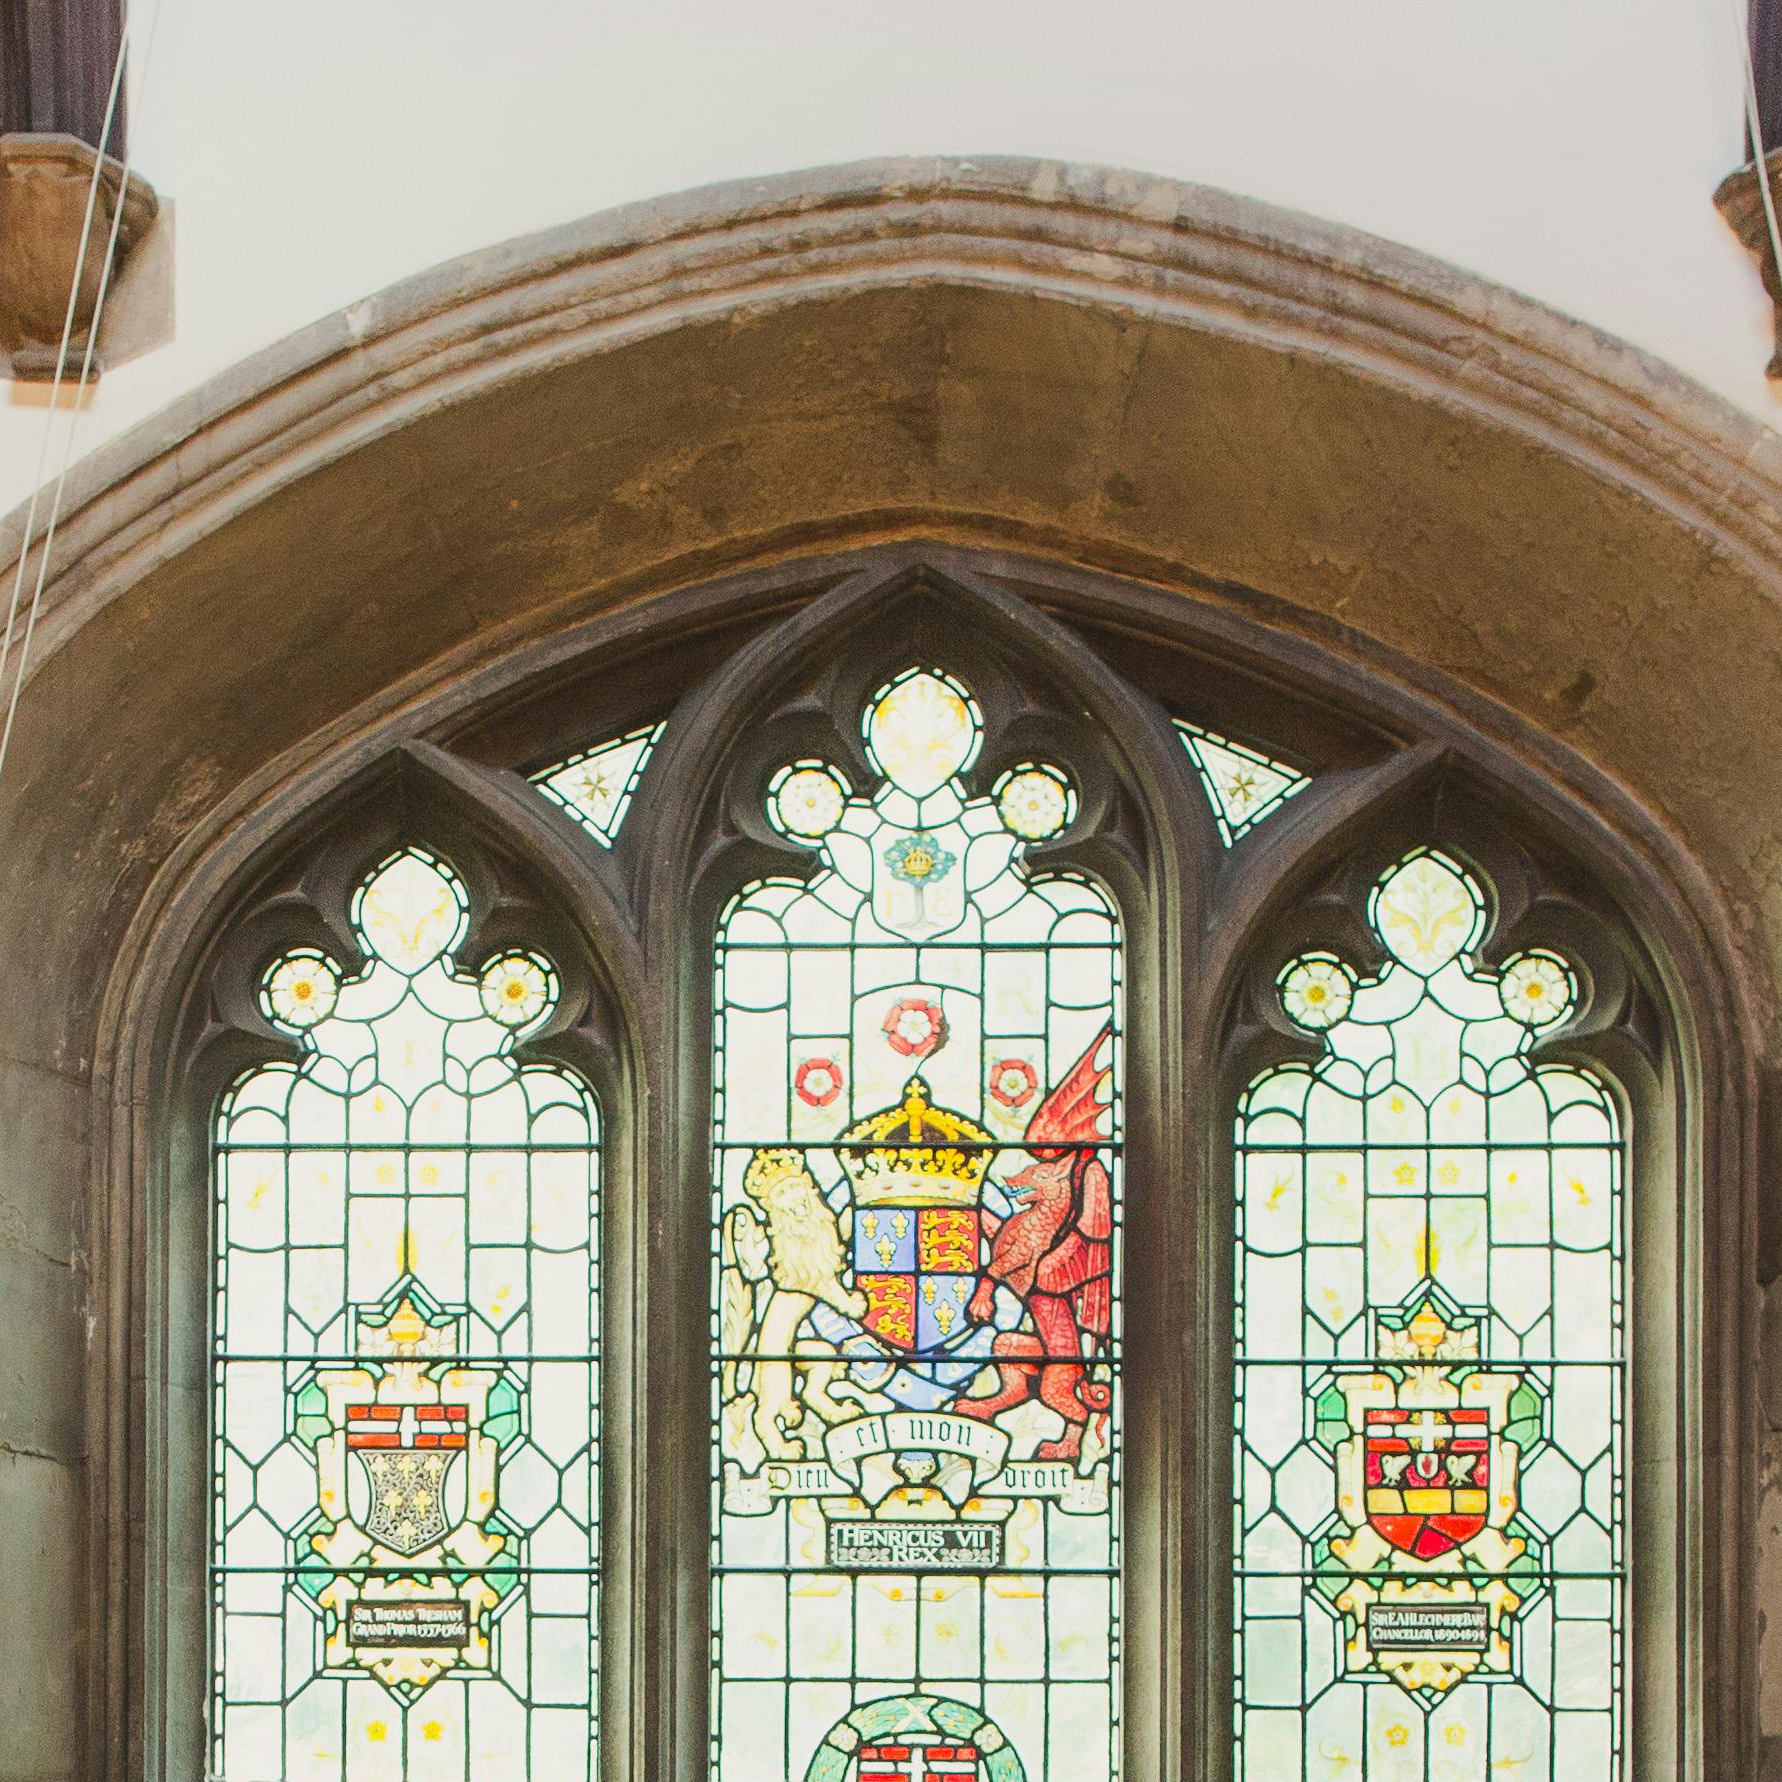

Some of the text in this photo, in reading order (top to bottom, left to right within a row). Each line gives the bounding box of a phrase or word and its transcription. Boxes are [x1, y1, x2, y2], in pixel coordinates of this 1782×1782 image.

[767, 1415, 1071, 1490] Dieu et mon droit
[841, 1526, 987, 1548] HENRICUS VII
[889, 1545, 942, 1563] REX
[353, 1607, 463, 1622] SIR THOMAS TRESHAM
[352, 1622, 386, 1636] GRAND
[387, 1622, 418, 1636] PRIOR
[1371, 1627, 1435, 1642] CHANCELLOR
